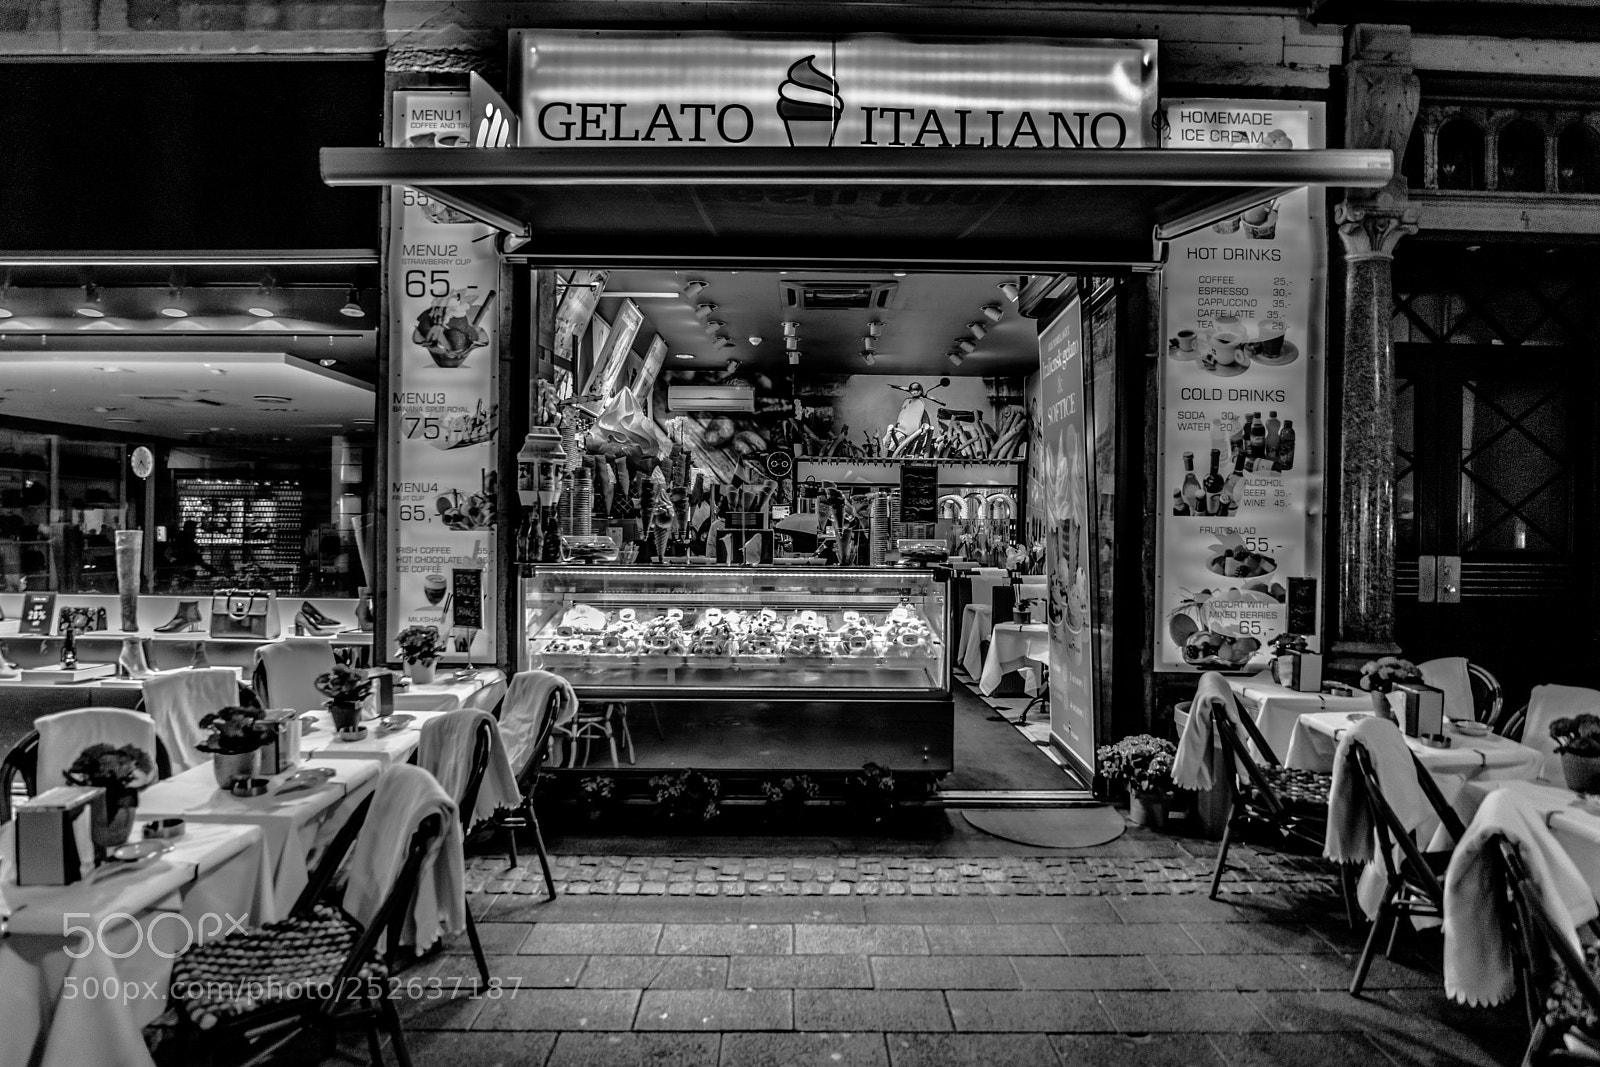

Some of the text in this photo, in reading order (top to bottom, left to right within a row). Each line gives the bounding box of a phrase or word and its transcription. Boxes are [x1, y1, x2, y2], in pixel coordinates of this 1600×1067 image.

[412, 109, 462, 121] MENU1
[1181, 111, 1272, 125] HOMEMADE
[538, 102, 1127, 148] GELATO ITALIANO
[1181, 129, 1264, 143] ICE CREAM
[402, 244, 458, 257] MENU2
[1187, 247, 1282, 261] HOT DRINKS
[1198, 275, 1235, 284] COFFEE
[1198, 287, 1249, 296] ESPRESSO
[1197, 298, 1258, 307] CAPPUCCINO
[1197, 309, 1227, 318] CAFFE
[1229, 310, 1255, 318] LATTE
[1197, 320, 1214, 328] TEA
[392, 392, 446, 404] MENU3
[1181, 387, 1286, 402] COLD DRINKS
[1177, 411, 1205, 420] SODA
[1177, 423, 1211, 431] WATER
[392, 482, 439, 493] MENU4
[1243, 479, 1284, 487] ALCOHOL
[1243, 489, 1266, 497] BEER
[1243, 499, 1266, 507] WINE
[1199, 526, 1256, 535] FRUIT SALAD
[396, 546, 418, 554] IRISH
[420, 546, 451, 554] COFFEE
[414, 556, 462, 564] CHOCOLATE
[396, 565, 409, 573] ICE
[411, 565, 442, 573] COFFEE
[1209, 600, 1269, 609] YOGURT WITH
[1209, 611, 1278, 620] MIXED BERRIES
